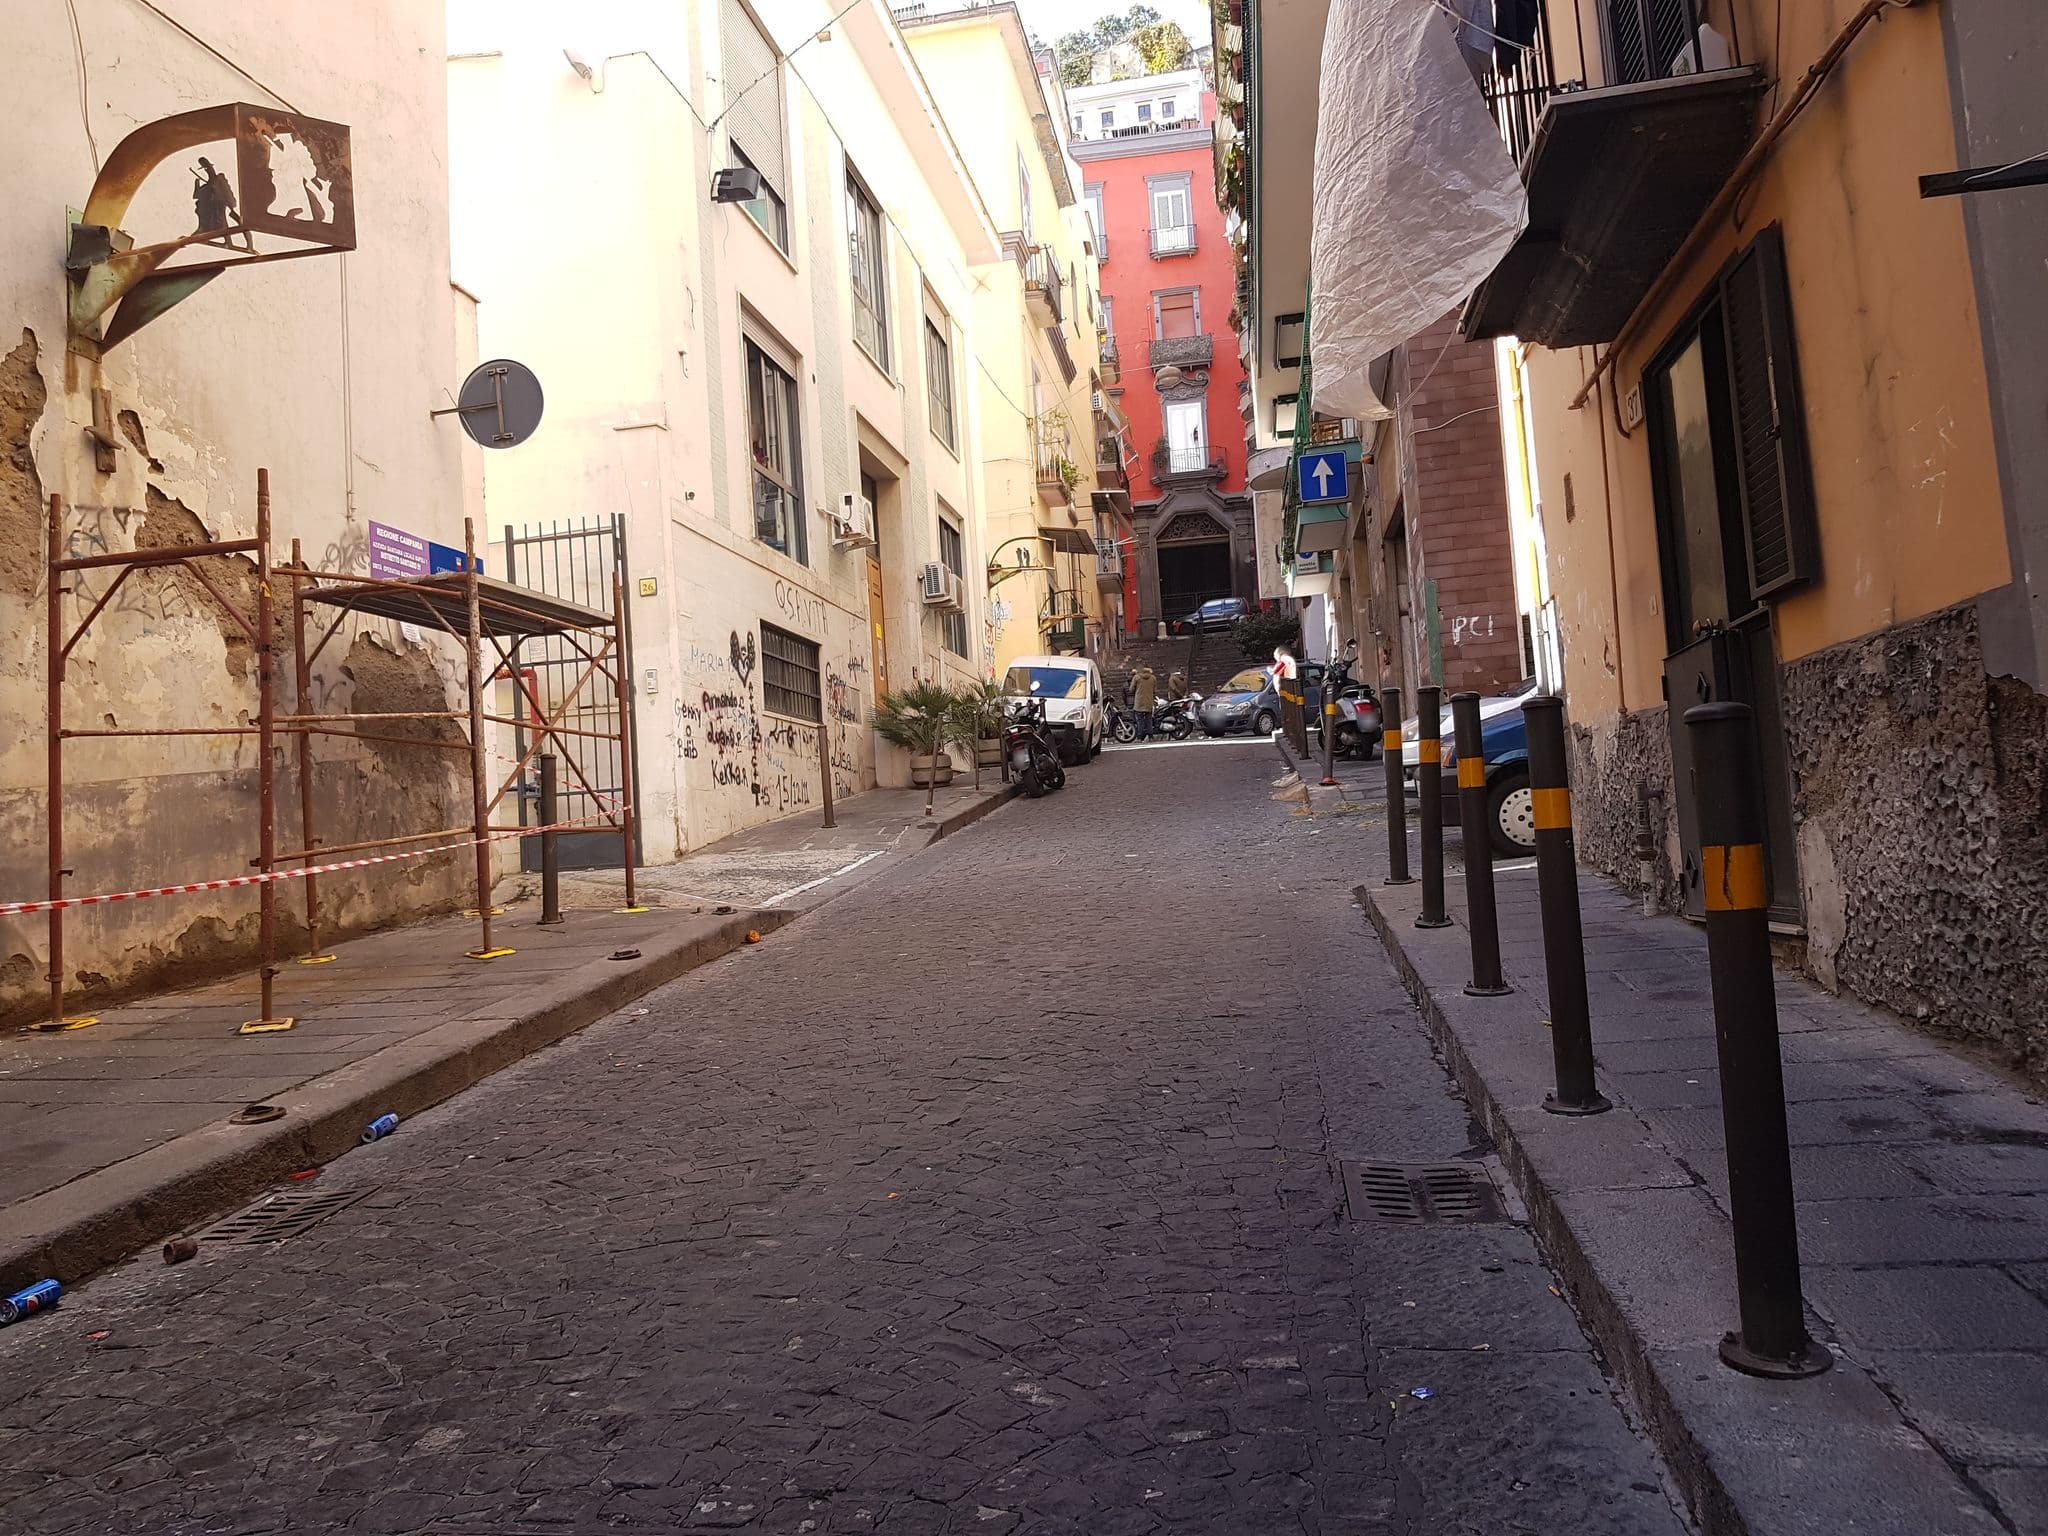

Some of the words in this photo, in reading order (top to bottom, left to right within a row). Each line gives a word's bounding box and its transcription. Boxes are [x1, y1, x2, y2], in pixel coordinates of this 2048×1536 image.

[1627, 389, 1638, 422] 37
[376, 527, 400, 542] REGIONE
[399, 535, 424, 551] CAMPANIA
[642, 583, 654, 592] 26
